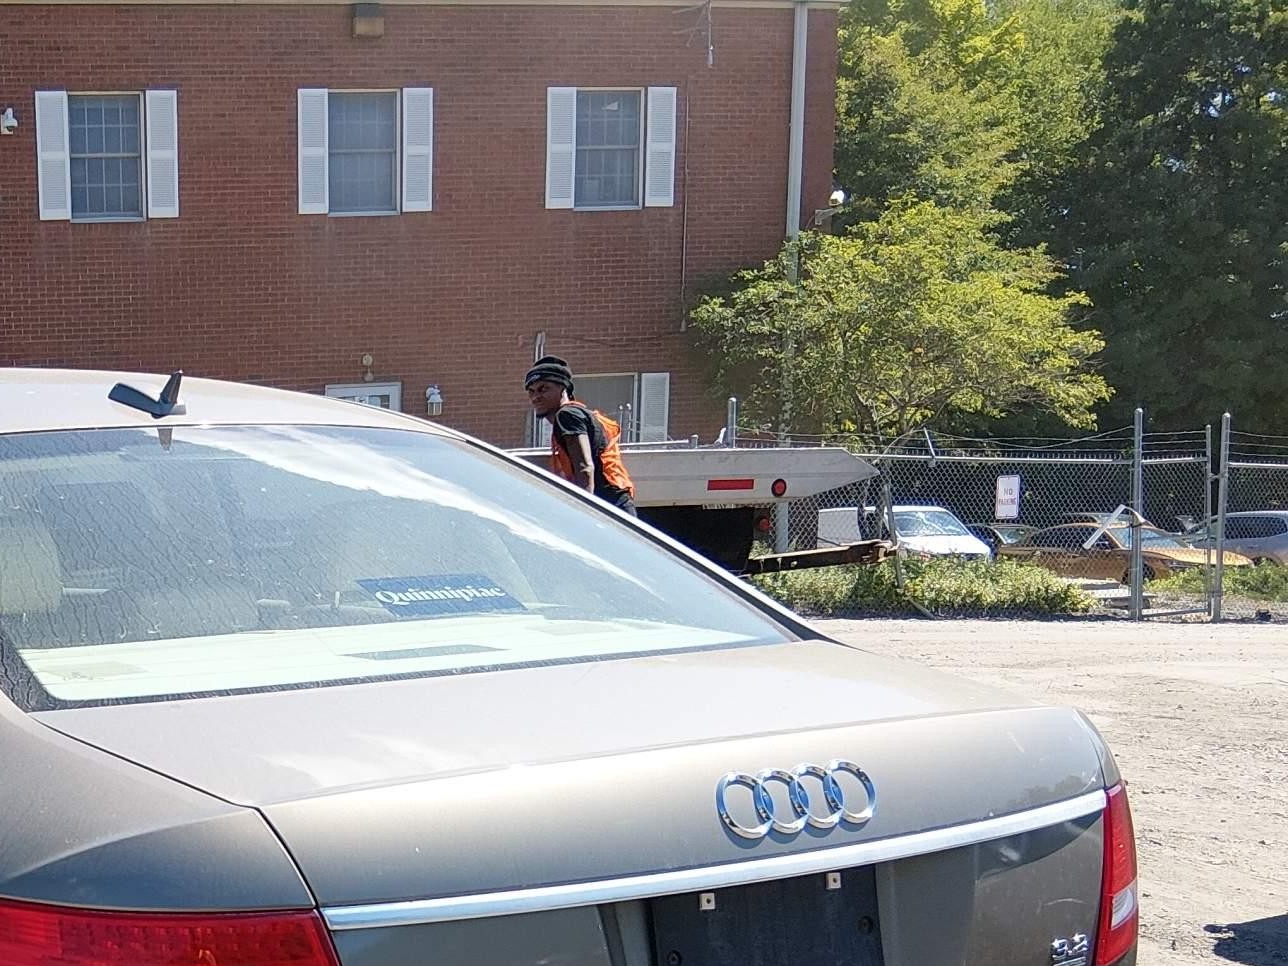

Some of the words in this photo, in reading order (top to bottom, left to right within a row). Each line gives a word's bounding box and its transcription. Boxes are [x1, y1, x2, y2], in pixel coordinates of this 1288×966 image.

[1003, 487, 1014, 496] NO
[998, 497, 1017, 506] PARKING
[375, 585, 507, 606] Quinnipiac
